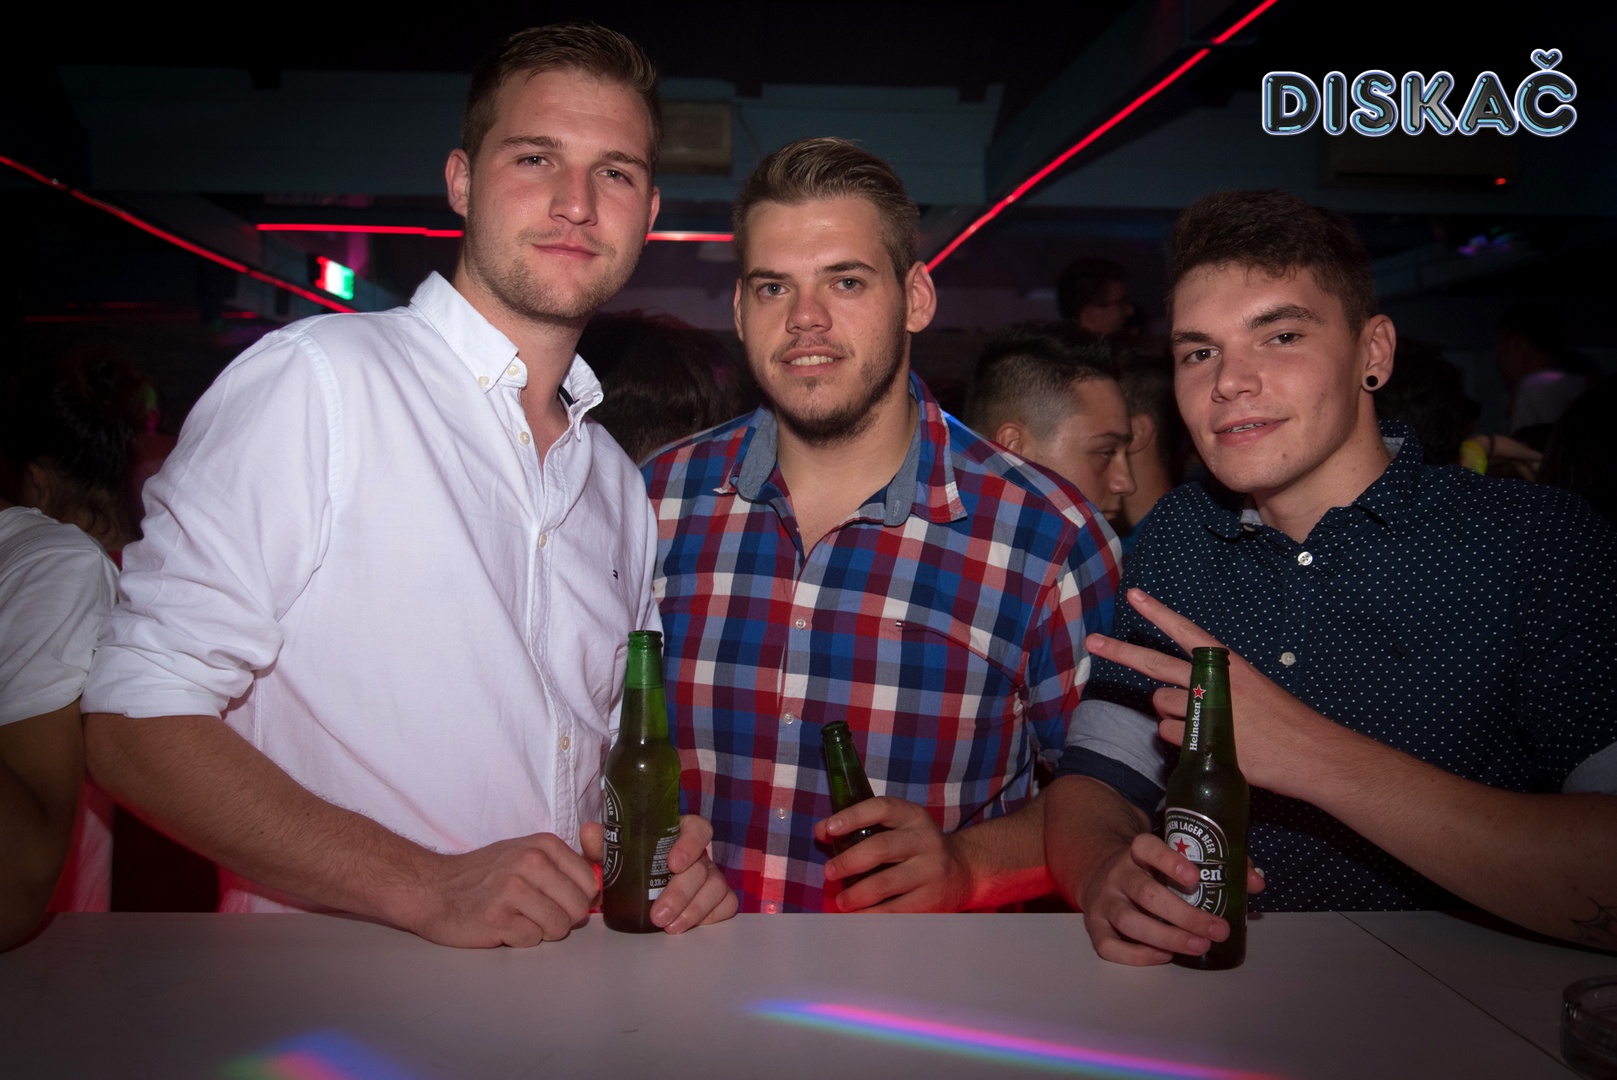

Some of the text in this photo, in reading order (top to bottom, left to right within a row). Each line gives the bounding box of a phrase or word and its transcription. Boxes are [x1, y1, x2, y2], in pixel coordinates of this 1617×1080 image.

[1189, 701, 1202, 752] Heineken
[1179, 820, 1204, 838] LAGER
[1201, 833, 1216, 854] BEER
